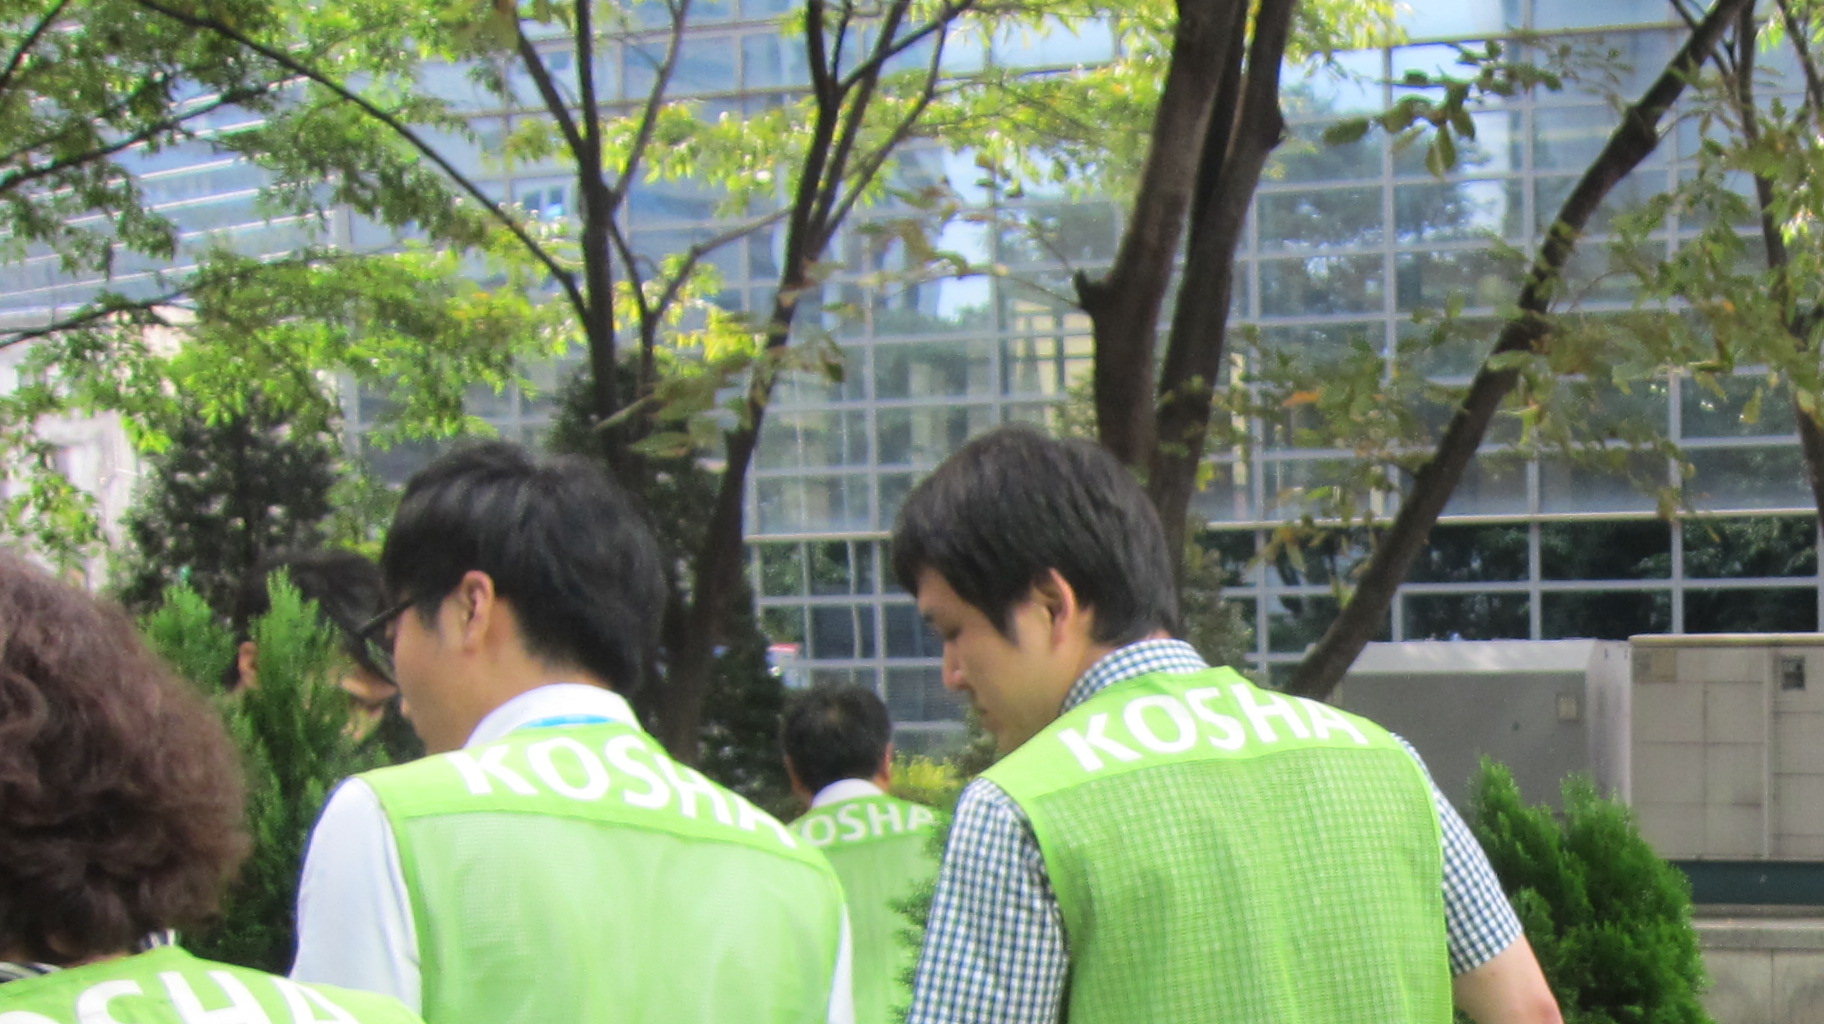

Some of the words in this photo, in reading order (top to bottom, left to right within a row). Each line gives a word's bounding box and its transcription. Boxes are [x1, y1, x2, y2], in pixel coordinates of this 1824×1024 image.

[1056, 682, 1369, 772] KOSHA
[446, 734, 797, 848] KOSHA
[793, 802, 940, 847] OSHA
